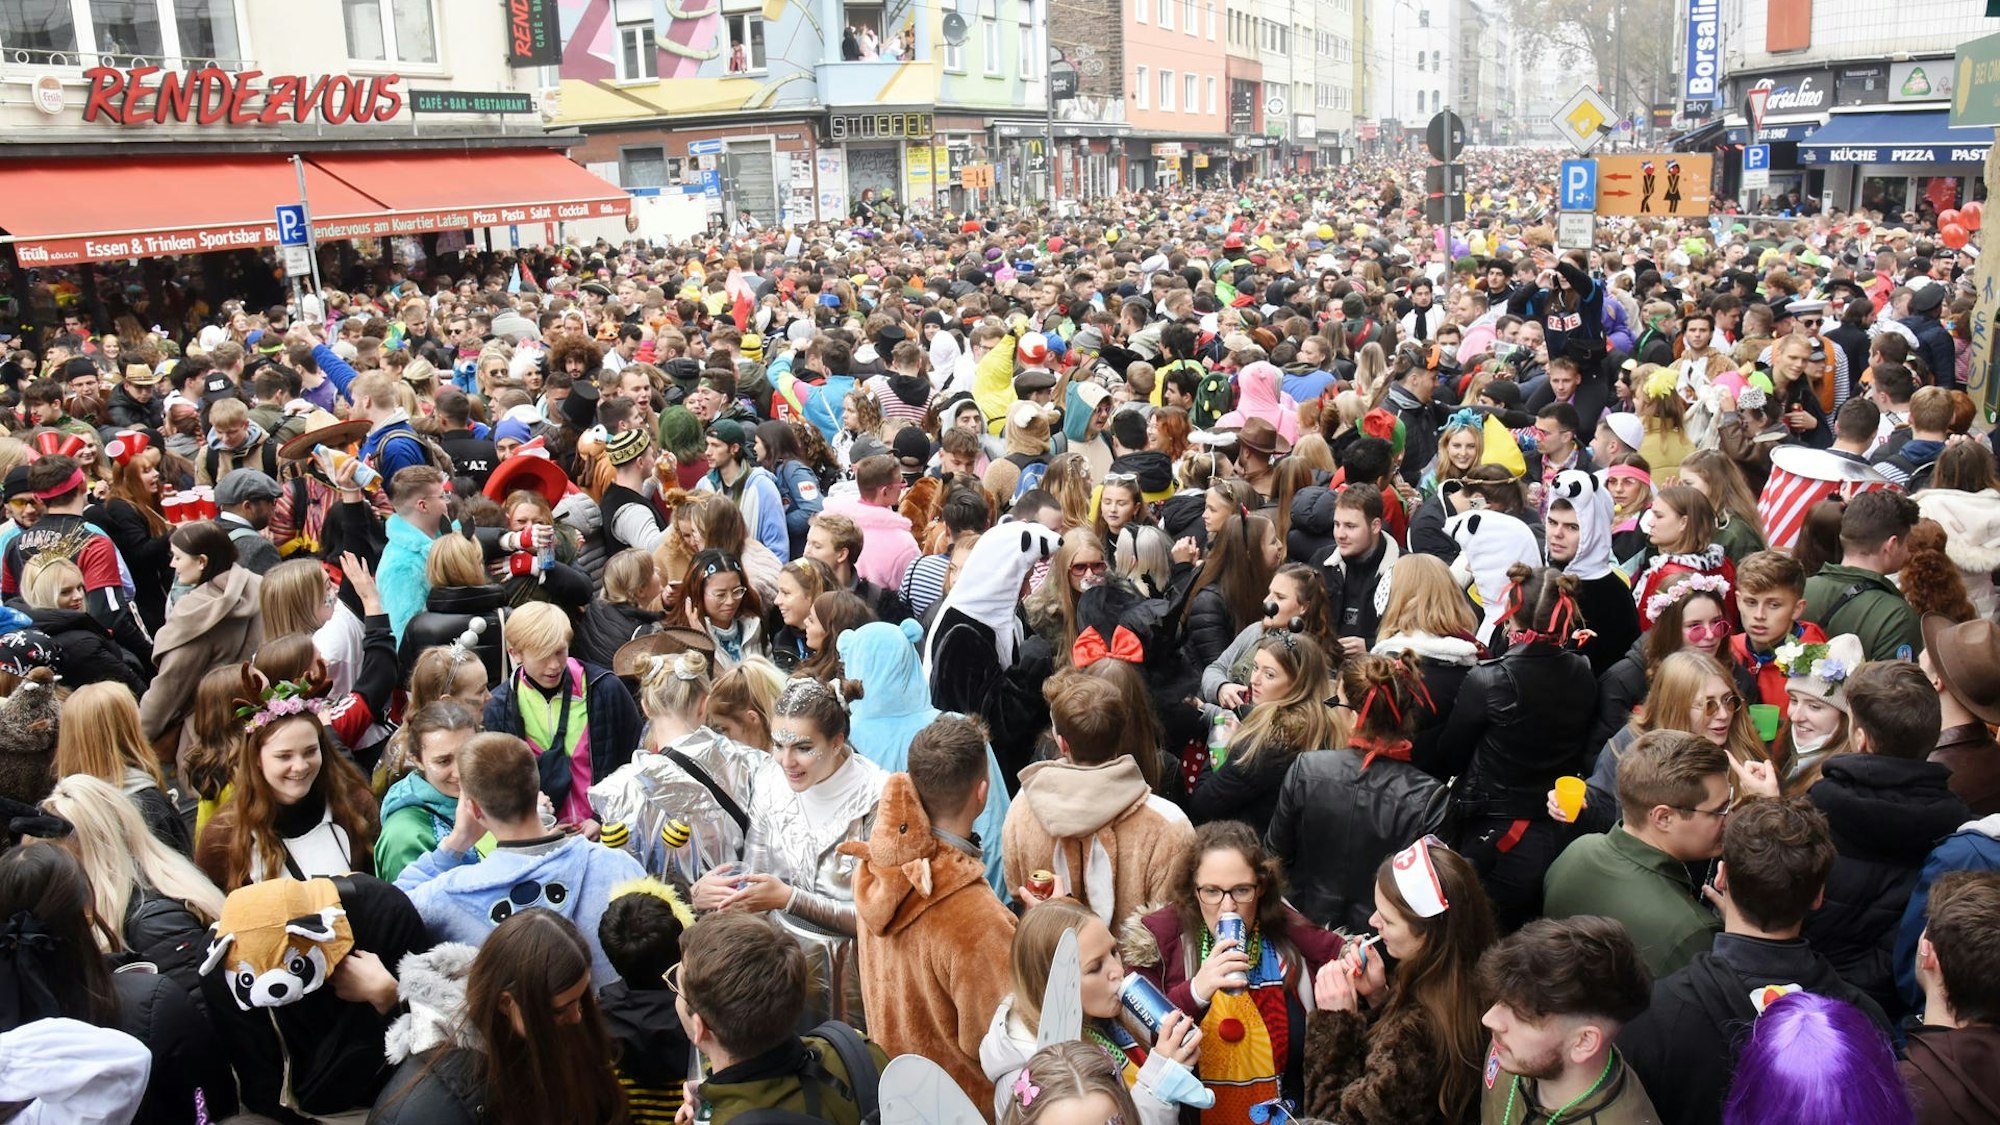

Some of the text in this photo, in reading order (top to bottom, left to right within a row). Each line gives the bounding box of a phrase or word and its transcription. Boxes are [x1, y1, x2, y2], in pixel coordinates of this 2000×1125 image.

[533, 22, 545, 48] CAFÉ
[1690, 0, 1717, 94] Borsali
[82, 65, 402, 125] RENDEZVOUS
[420, 95, 527, 111] CAFÉ BAR RESTAURANT
[1686, 101, 1708, 114] sky
[1755, 78, 1823, 109] orsalino
[833, 115, 934, 138] STIEFEL
[1830, 148, 1877, 161] KÜCHE
[1891, 149, 1935, 161] PIZZA
[85, 239, 131, 258] Essen
[131, 239, 144, 255] &
[145, 235, 196, 253] Trinken
[199, 229, 261, 248] Sportsbar
[314, 220, 371, 239] endezvous
[374, 222, 389, 233] am
[392, 216, 434, 231] Kwartier
[437, 213, 469, 229] Latäng
[473, 211, 497, 225] Pizza
[501, 208, 525, 222] Pasta
[530, 206, 551, 220] Salat
[558, 203, 590, 217] Cocktail
[1125, 993, 1155, 1027] ENERGY
